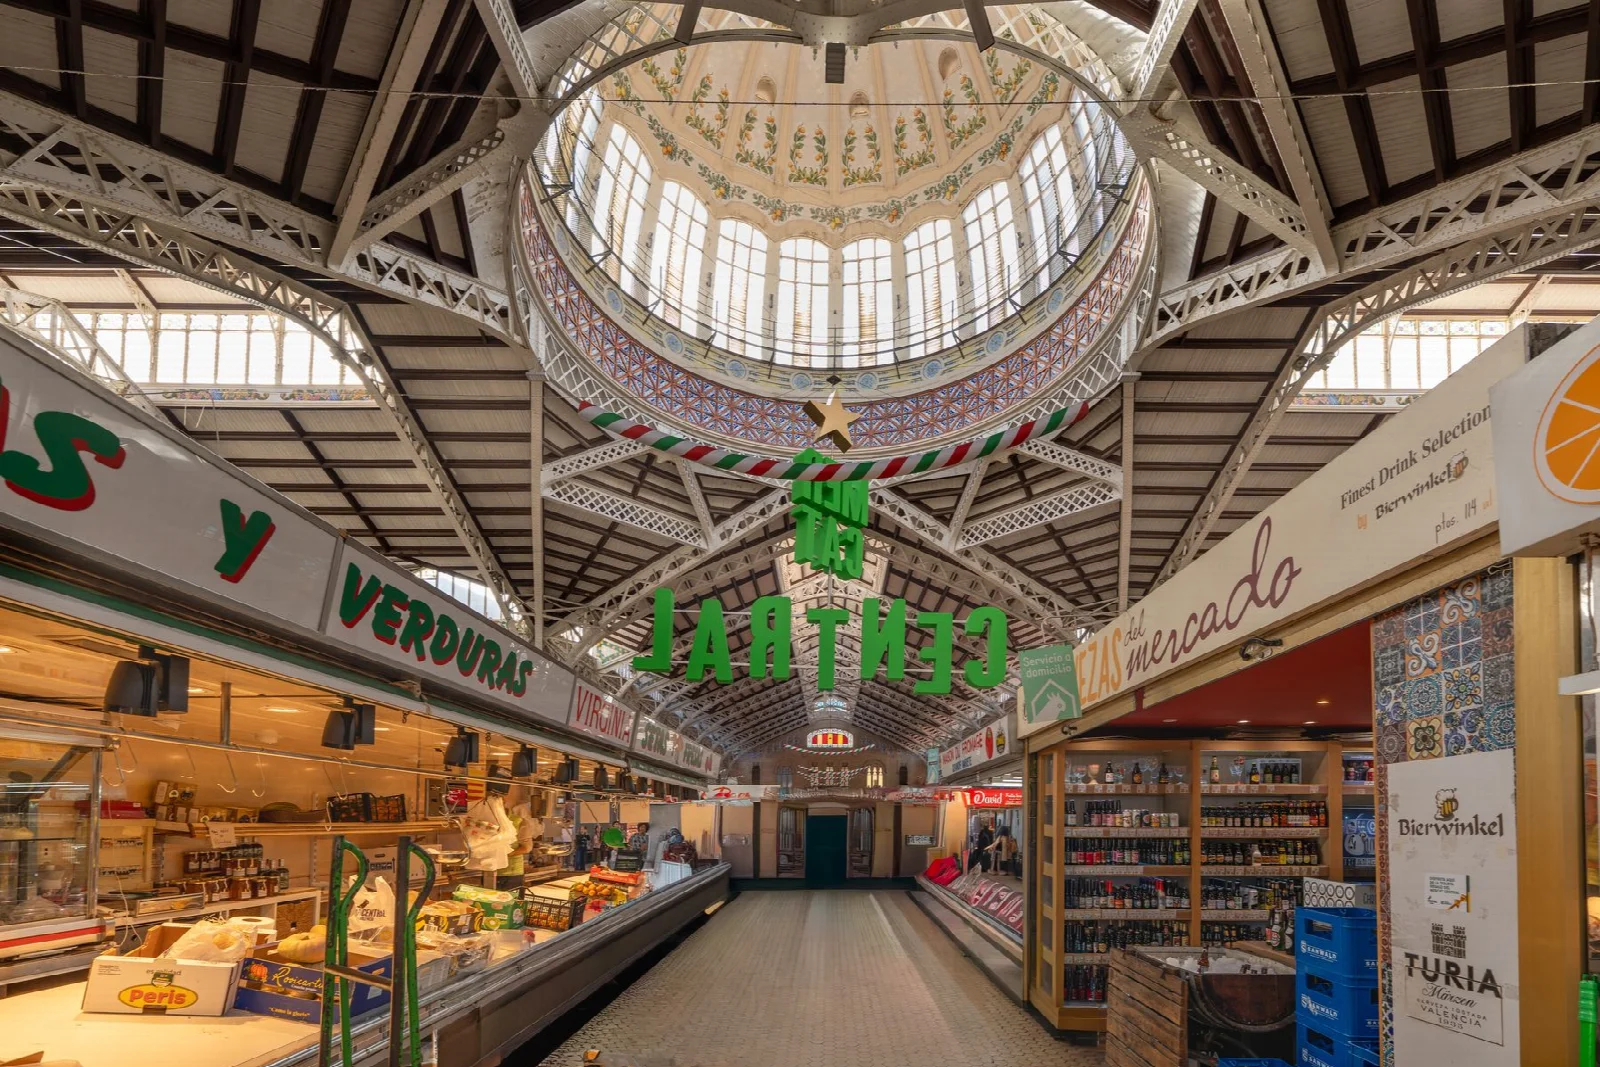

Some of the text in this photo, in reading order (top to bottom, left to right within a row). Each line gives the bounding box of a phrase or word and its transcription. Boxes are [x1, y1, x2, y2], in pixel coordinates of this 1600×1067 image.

[1340, 405, 1491, 510] Finest Drink Selection
[1375, 462, 1454, 520] Bierwinkel
[0, 376, 533, 697] S Y VERDURAS
[1075, 516, 1302, 705] EZAS del mercado
[1023, 655, 1063, 667] Servicio
[1026, 665, 1071, 678] domicilio
[576, 686, 631, 743] VIRGINIA
[973, 790, 1003, 804] David
[1398, 813, 1504, 837] Bierwinkel
[1307, 945, 1337, 960] SANWALD
[1404, 952, 1503, 999] TURIA
[129, 989, 187, 1005] Peris
[1422, 982, 1478, 1008] Märzen
[1420, 1004, 1482, 1028] VALENCIA
[1439, 1017, 1464, 1030] 1935
[1452, 1006, 1487, 1020] TOSTADA
